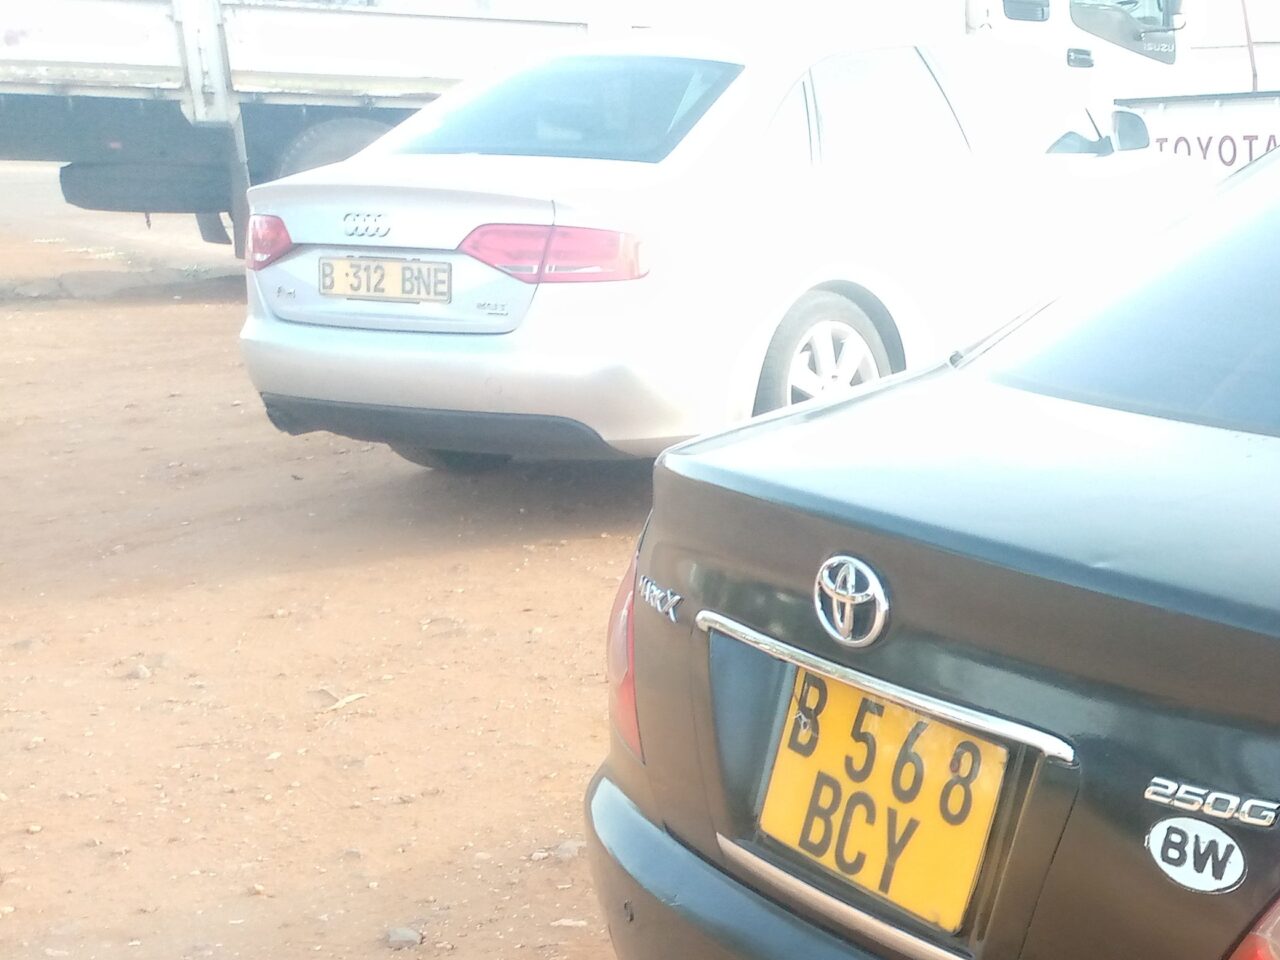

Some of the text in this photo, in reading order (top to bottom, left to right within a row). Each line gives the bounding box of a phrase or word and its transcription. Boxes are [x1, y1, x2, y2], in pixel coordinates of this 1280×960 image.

[1143, 42, 1175, 52] ISUZU
[321, 262, 448, 297] B 312 BNE
[787, 671, 982, 826] B 568
[798, 769, 921, 895] BCY
[1160, 825, 1236, 881] BW
